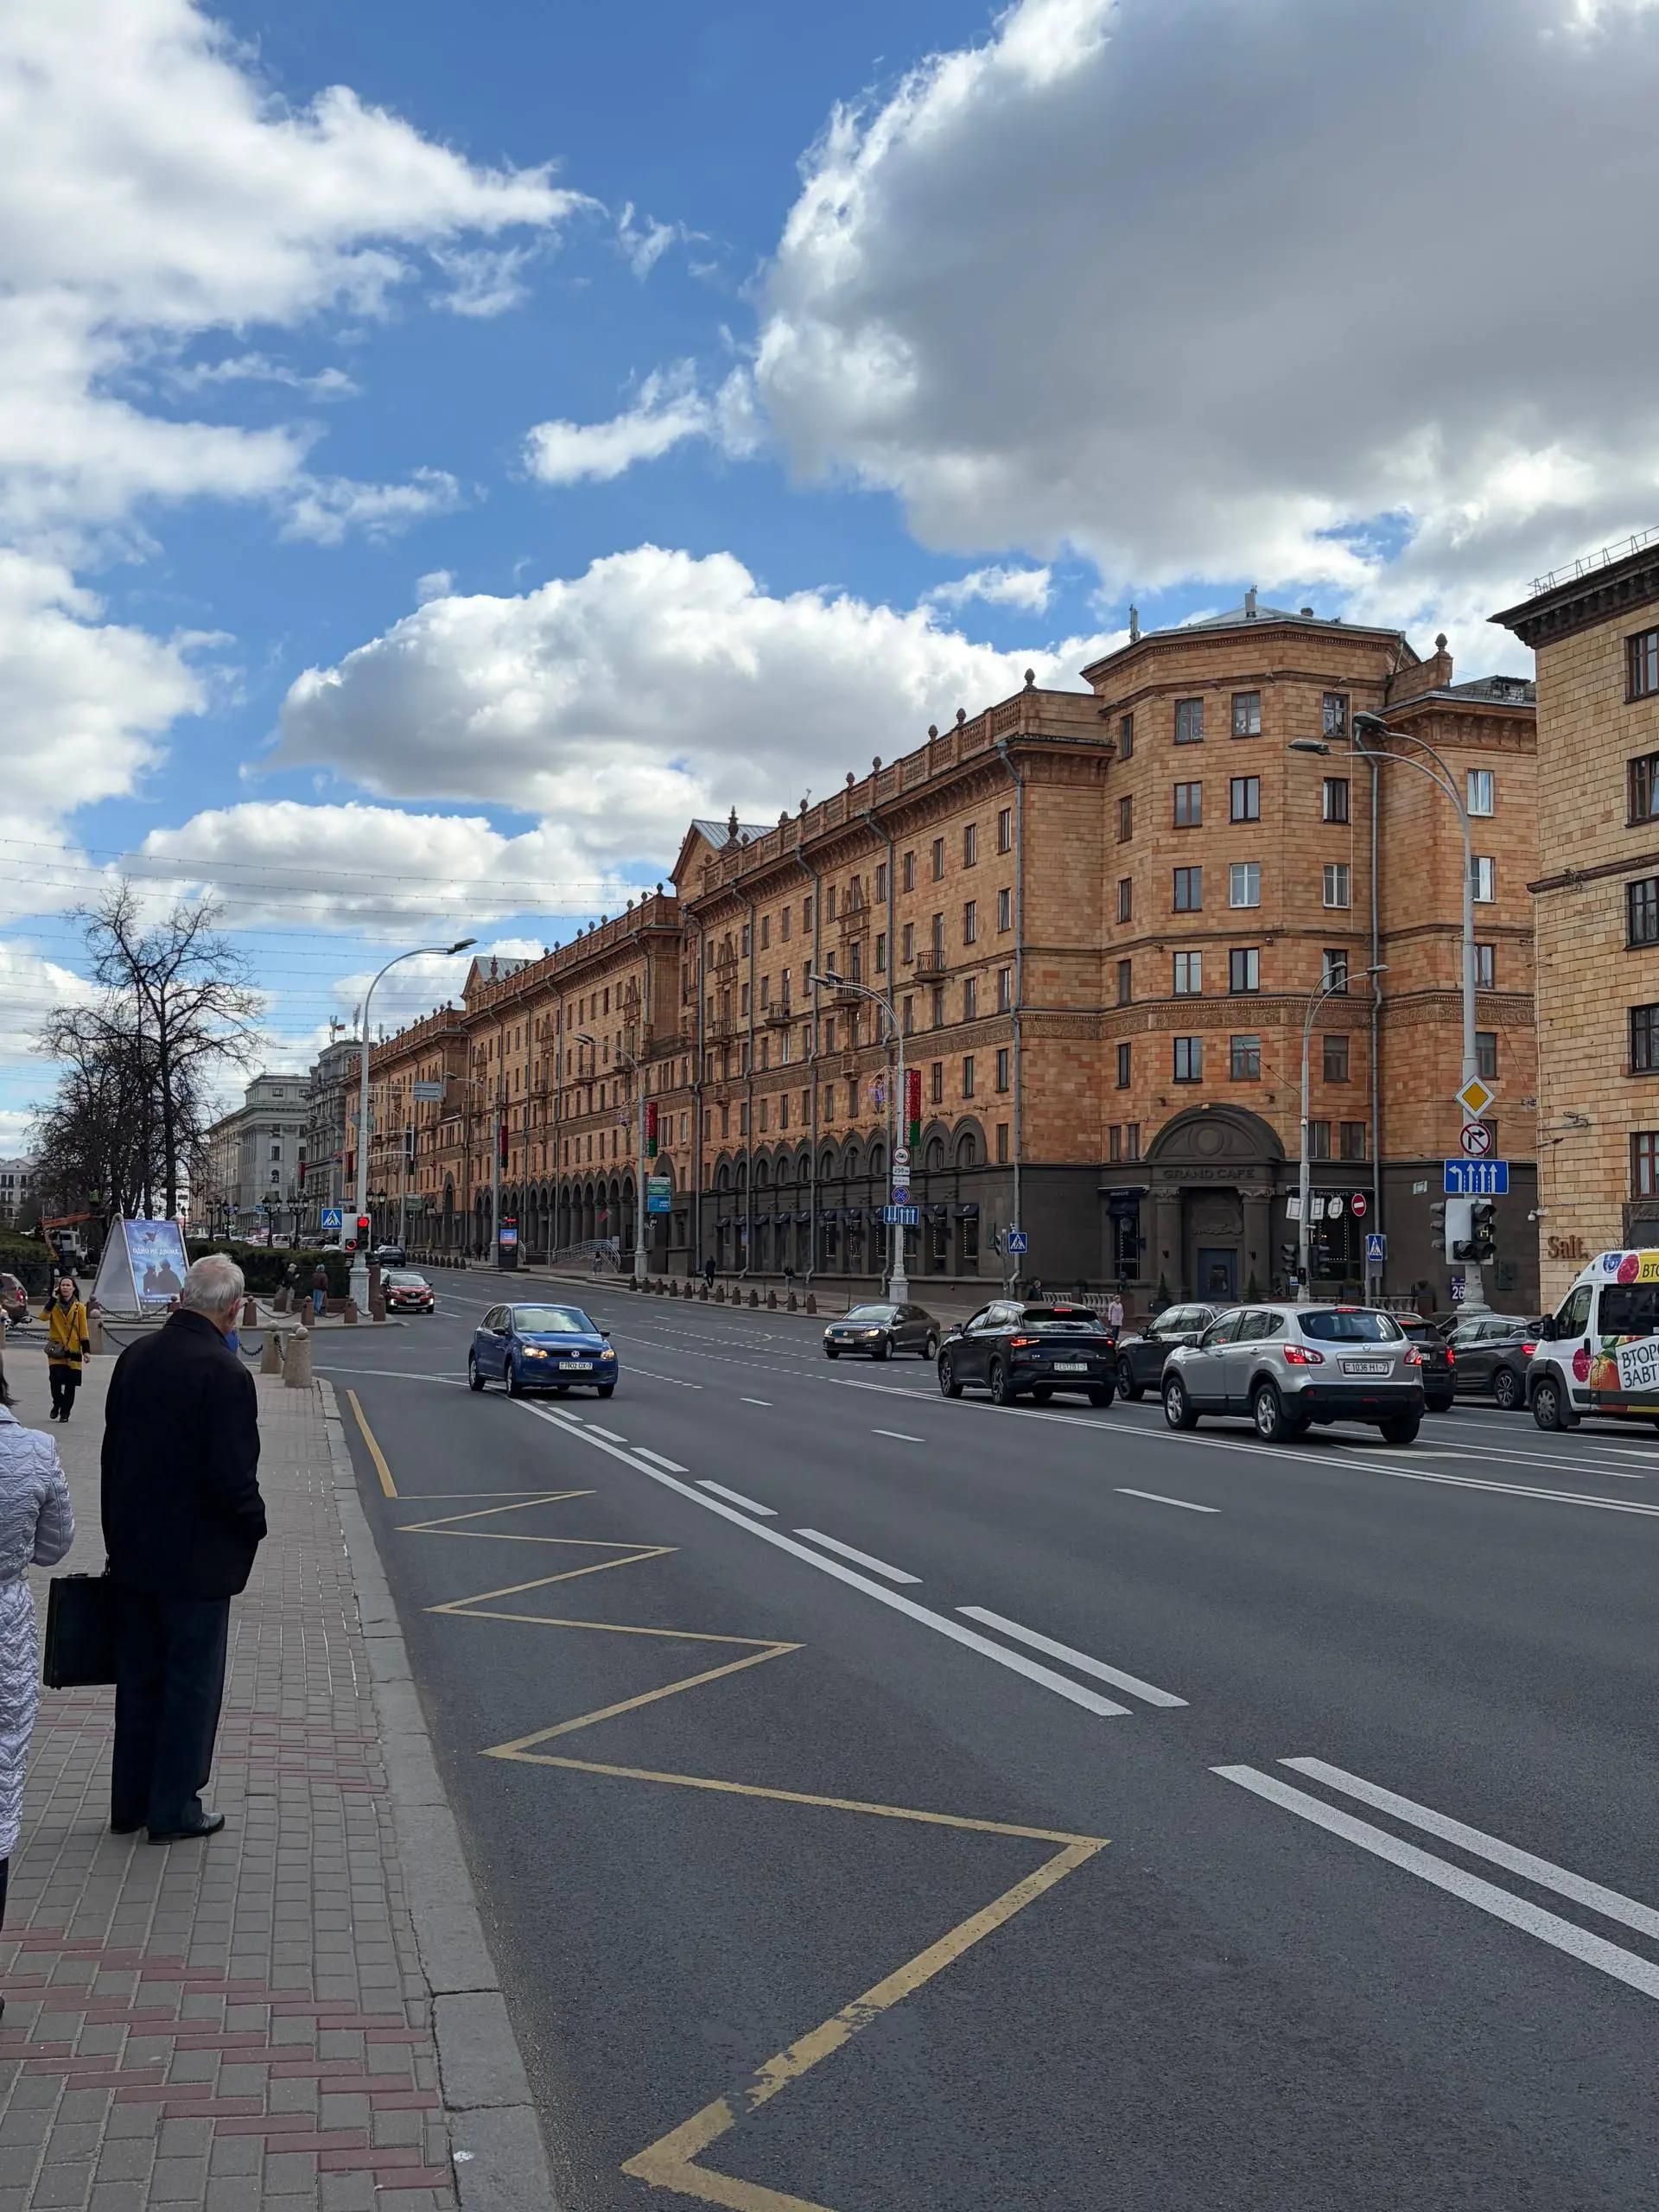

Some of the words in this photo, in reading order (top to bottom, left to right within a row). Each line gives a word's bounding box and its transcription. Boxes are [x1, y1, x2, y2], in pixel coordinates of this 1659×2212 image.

[1163, 1169, 1213, 1179] GRAND
[1621, 1344, 1659, 1369] ВТОР
[1623, 1363, 1659, 1389] ЗАВТ
